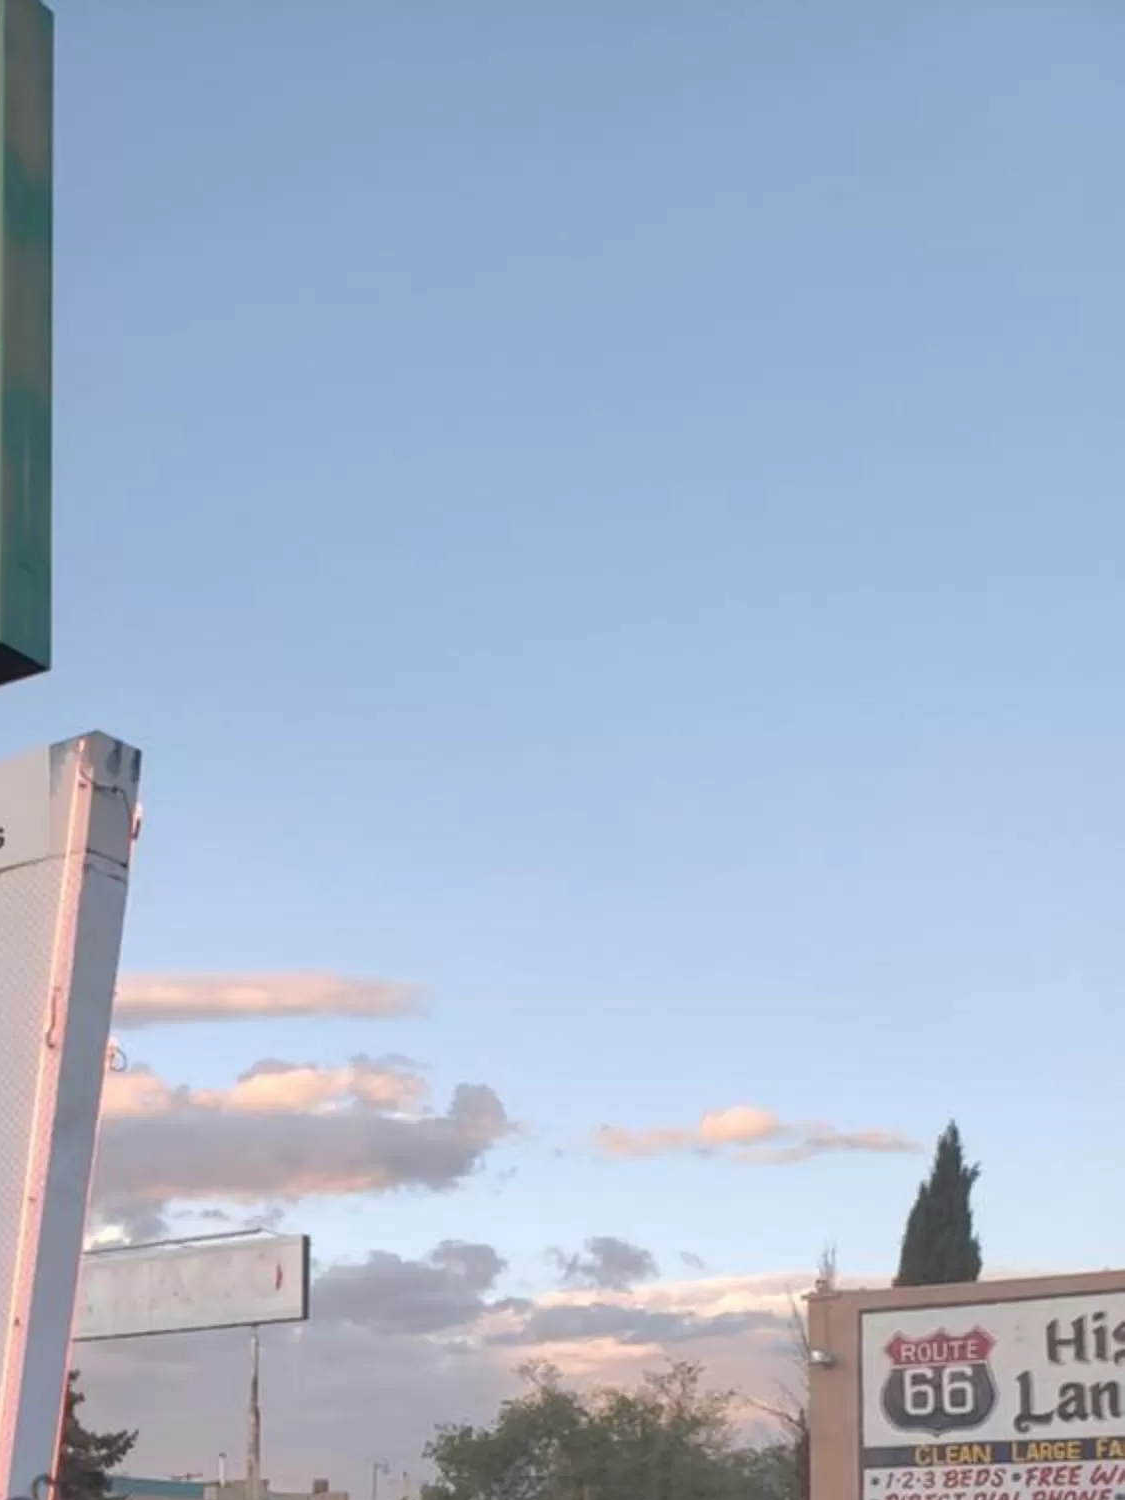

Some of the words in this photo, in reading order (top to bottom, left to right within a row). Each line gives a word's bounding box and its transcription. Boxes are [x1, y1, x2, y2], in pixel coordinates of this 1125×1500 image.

[900, 1338, 979, 1362] ROUTE
[903, 1366, 974, 1416] 66
[915, 1444, 991, 1465] CLEAN
[1011, 1441, 1082, 1461] LARGE
[943, 1468, 1007, 1488] BEDS
[1025, 1465, 1083, 1486] FREE
